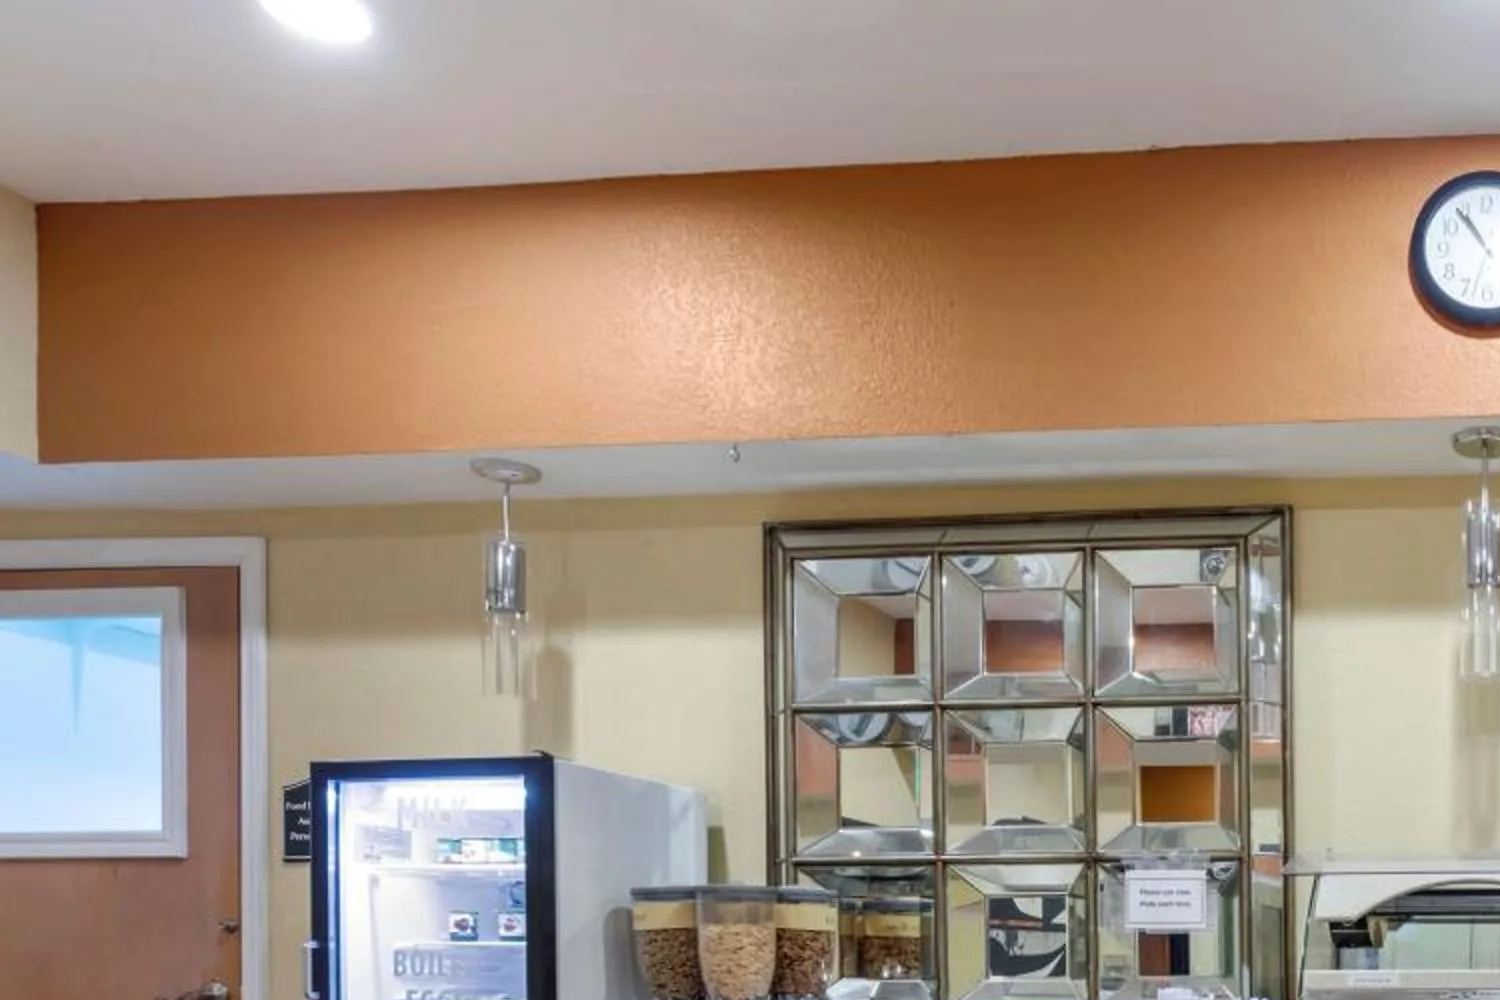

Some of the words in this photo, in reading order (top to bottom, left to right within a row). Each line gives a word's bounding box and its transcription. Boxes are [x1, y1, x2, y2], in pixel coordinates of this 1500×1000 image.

[1480, 195, 1494, 214] 12
[1442, 217, 1458, 237] 10
[1437, 240, 1450, 259] 9
[1443, 263, 1455, 279] 8
[1461, 277, 1471, 298] 7
[1481, 285, 1494, 302] 6
